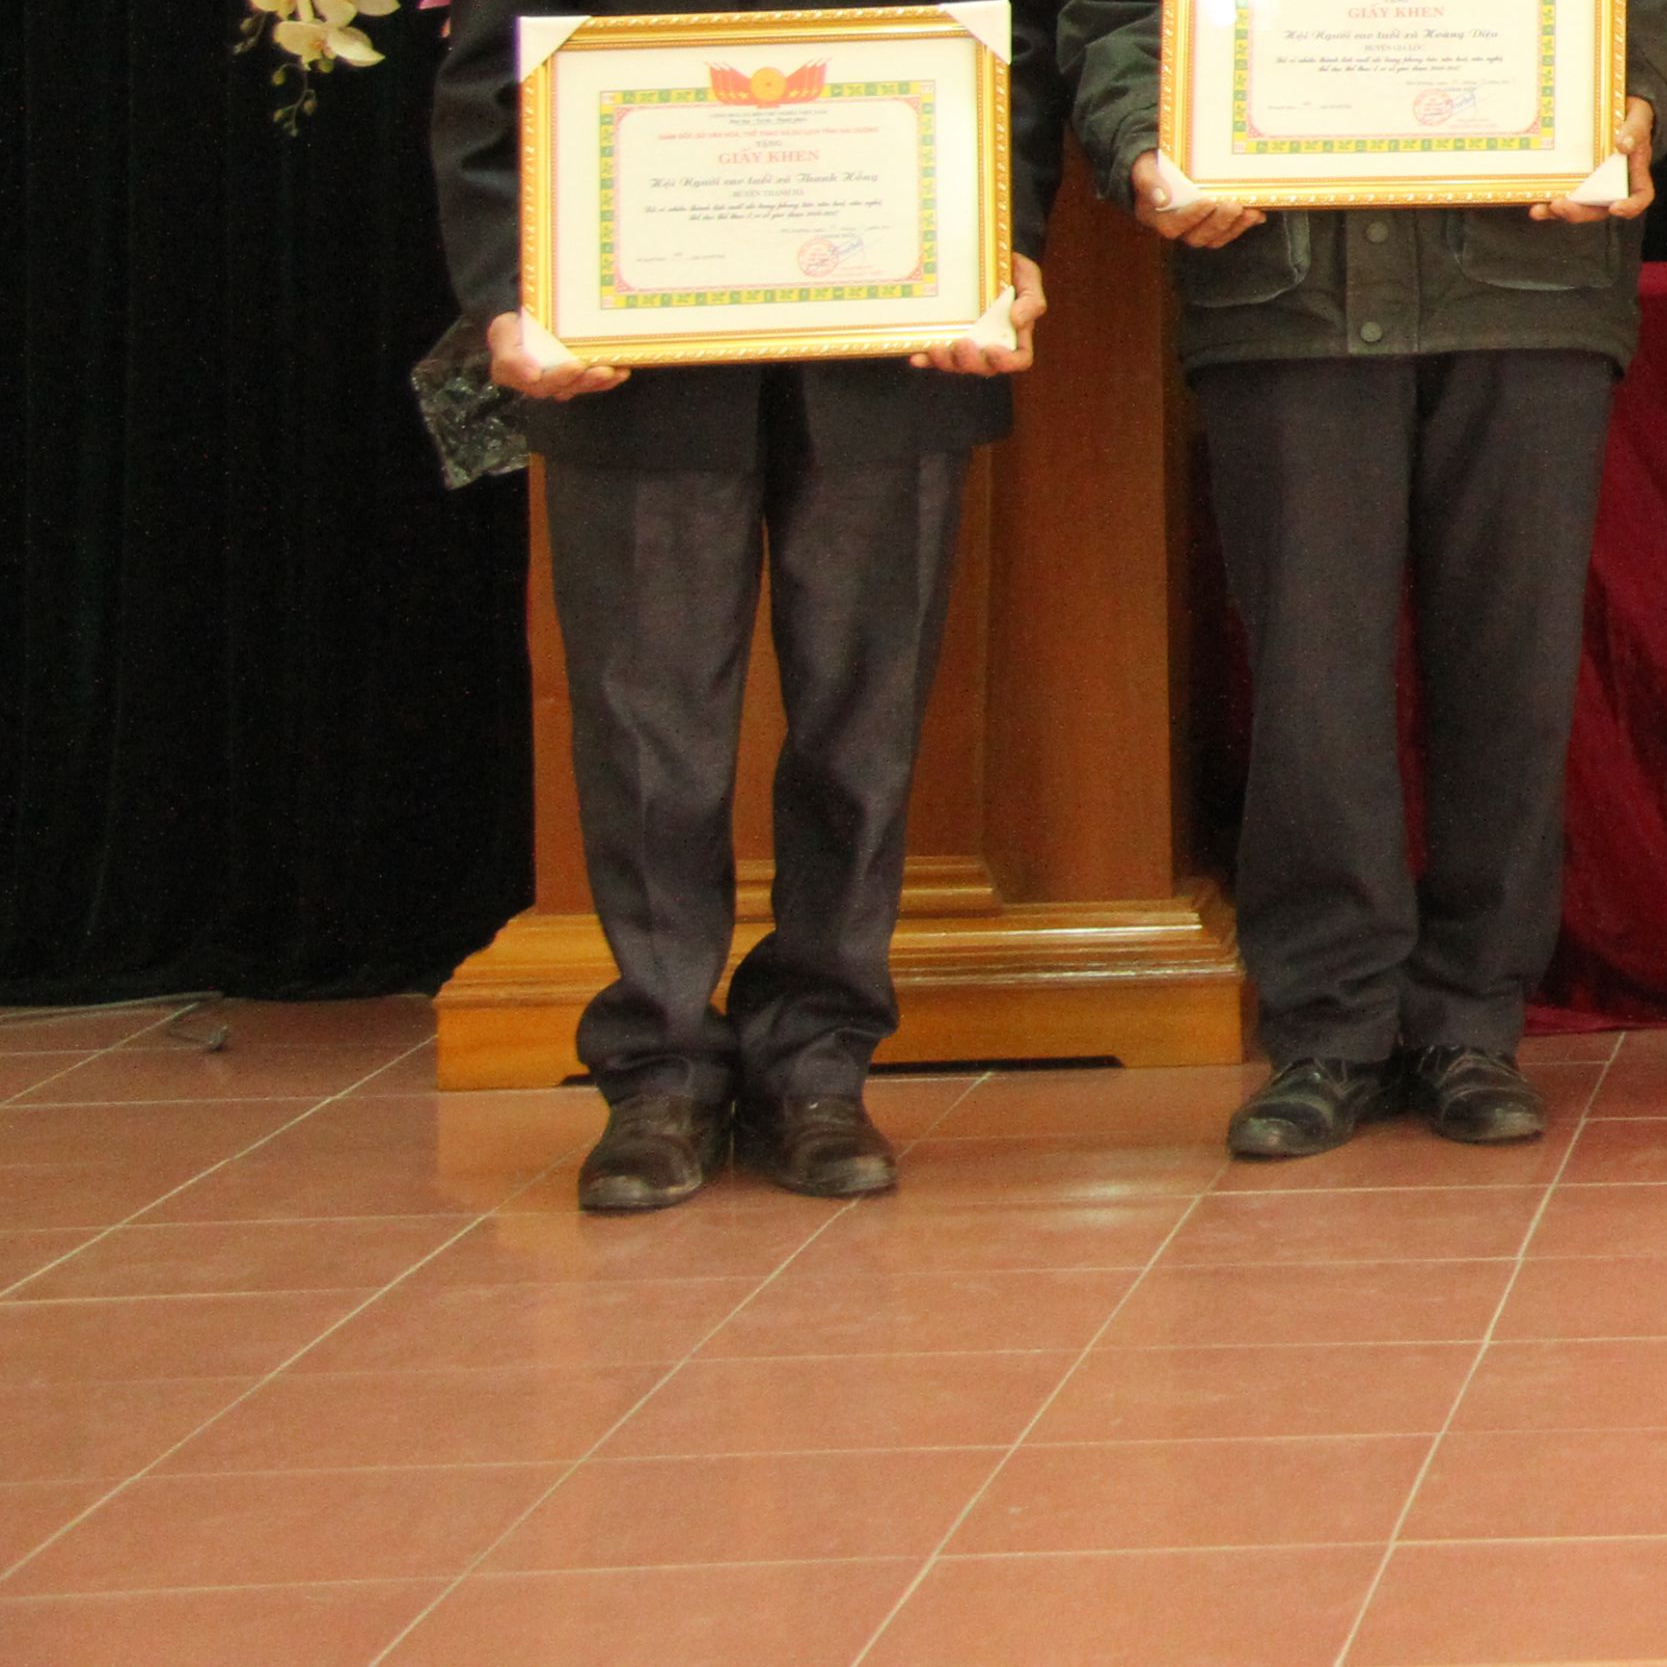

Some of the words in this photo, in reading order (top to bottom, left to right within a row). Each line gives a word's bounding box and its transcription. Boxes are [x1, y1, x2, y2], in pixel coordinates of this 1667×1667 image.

[1395, 6, 1445, 19] KHEN
[718, 146, 762, 165] GIẤY
[769, 150, 820, 163] KHEN
